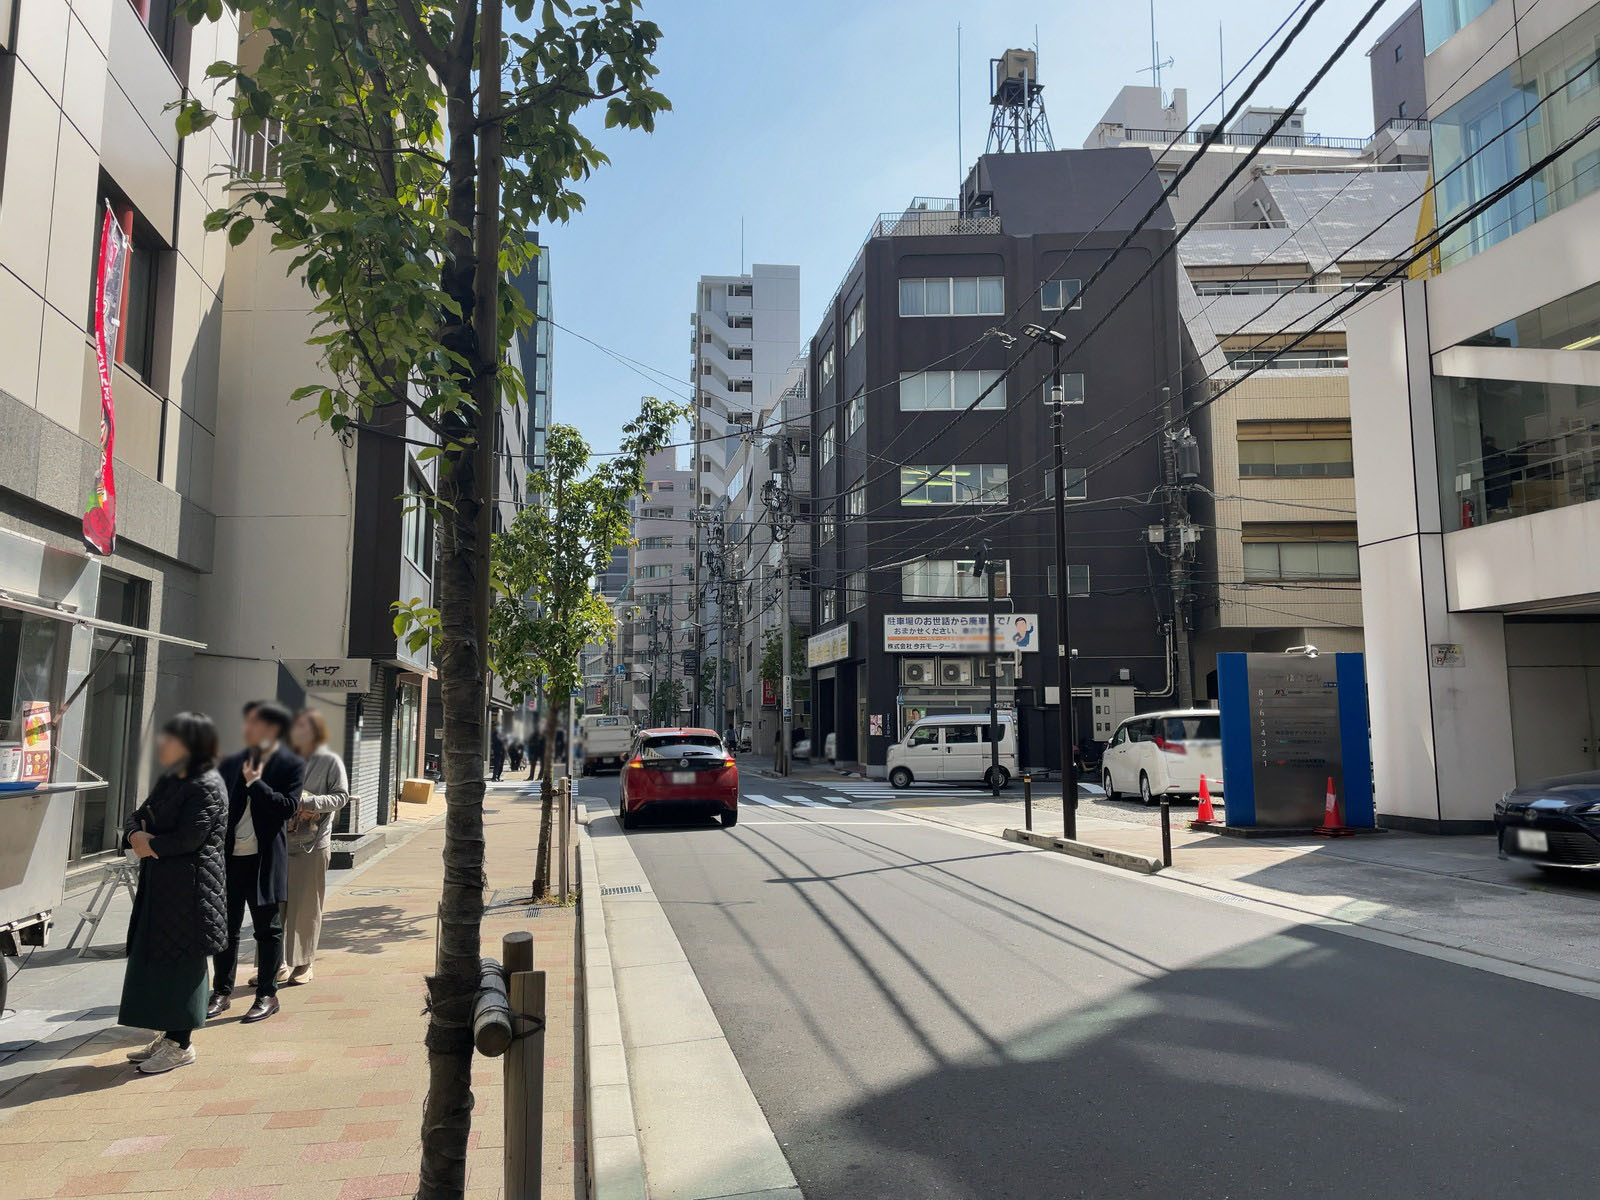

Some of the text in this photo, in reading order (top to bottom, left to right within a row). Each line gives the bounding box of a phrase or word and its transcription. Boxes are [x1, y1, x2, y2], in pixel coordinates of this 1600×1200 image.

[887, 616, 1011, 625] 駐車場のお世話から廃車で!
[331, 679, 358, 687] ANNEX
